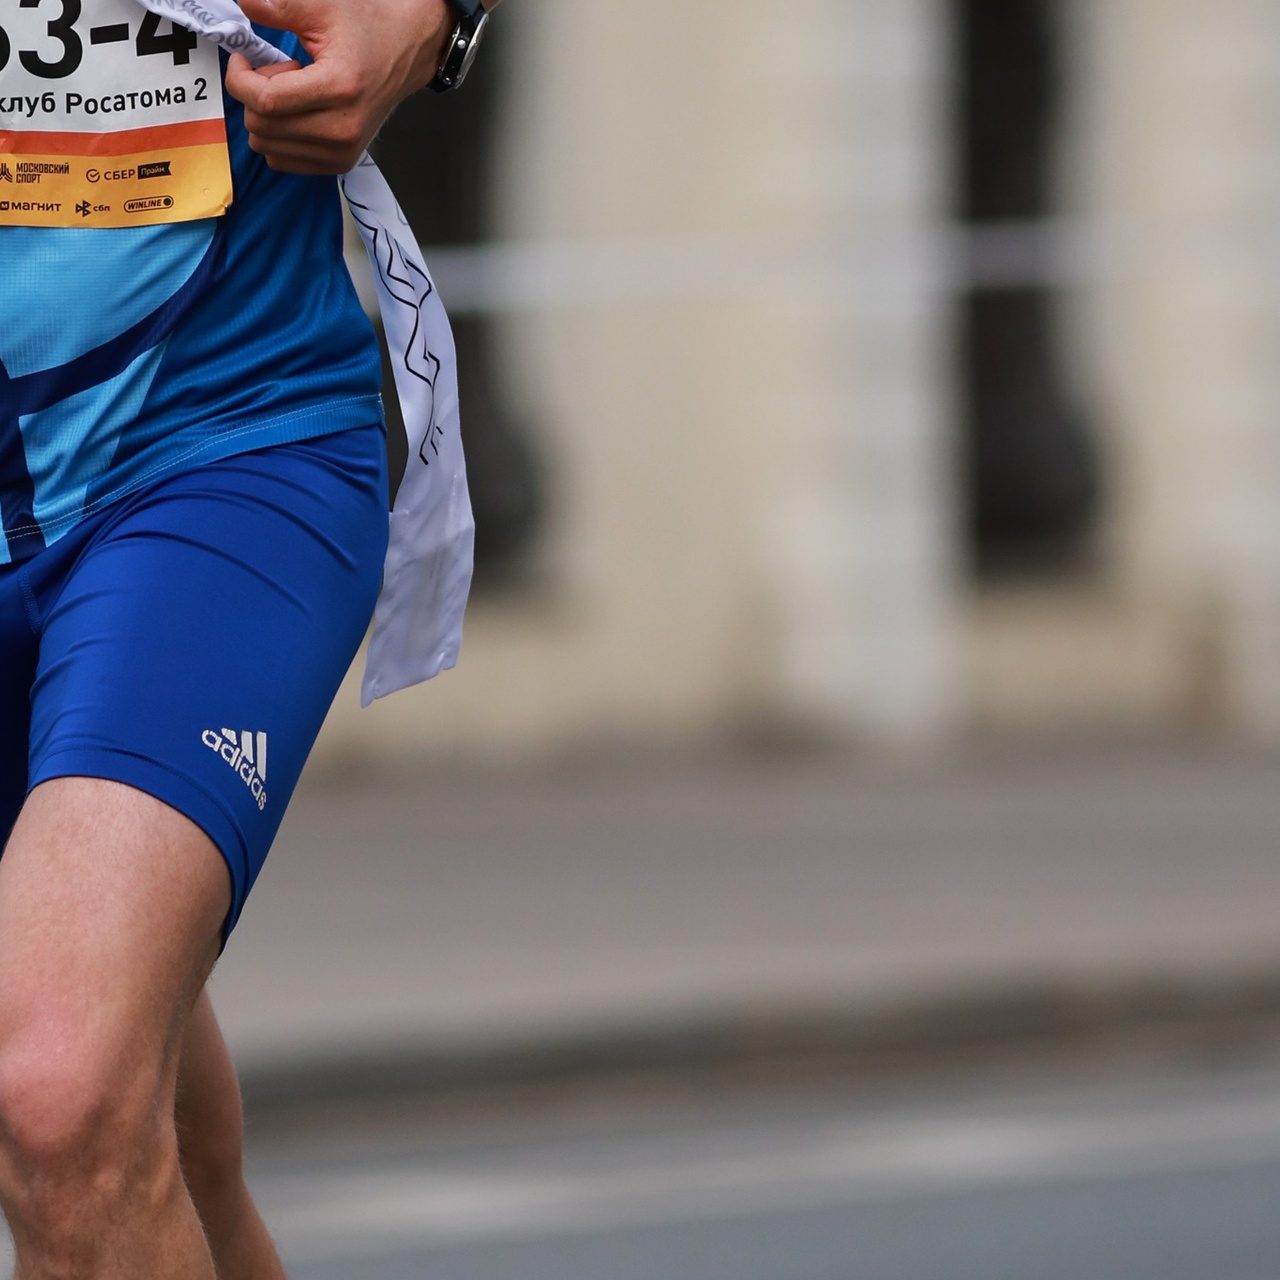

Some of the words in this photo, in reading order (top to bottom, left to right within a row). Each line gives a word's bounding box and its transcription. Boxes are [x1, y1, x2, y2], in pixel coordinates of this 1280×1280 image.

[66, 86, 186, 114] Росатома
[194, 77, 207, 100] 2
[16, 162, 70, 175] МОСКОВСКИЙ
[103, 169, 135, 181] СБЕР
[140, 166, 165, 176] Прайм
[16, 173, 41, 183] СПОРТ
[127, 199, 162, 210] WINLINE
[202, 730, 266, 810] adidas
